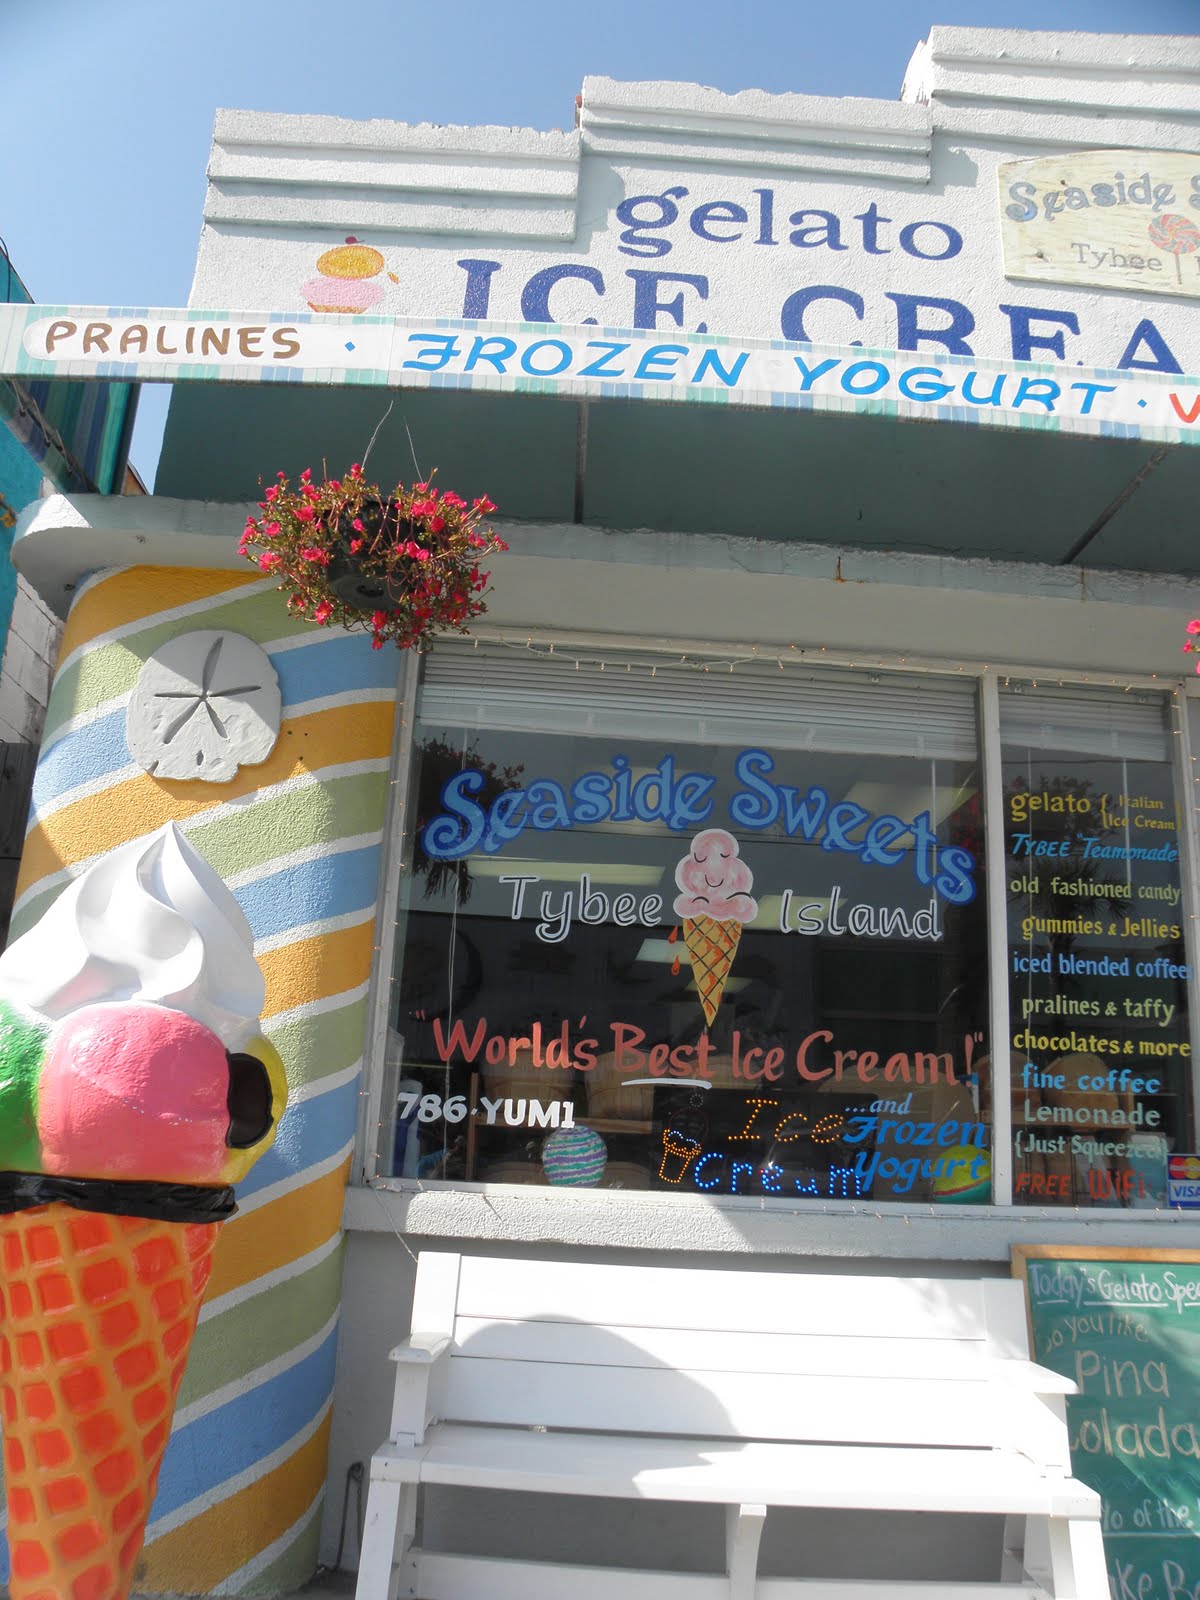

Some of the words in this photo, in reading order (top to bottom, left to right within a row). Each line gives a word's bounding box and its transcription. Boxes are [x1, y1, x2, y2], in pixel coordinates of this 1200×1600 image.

[1005, 172, 1176, 221] Seaside
[616, 186, 964, 260] gelato
[1071, 242, 1163, 272] Tybee
[457, 258, 710, 334] ICE
[45, 320, 301, 360] PRALINES
[402, 333, 751, 387] FROZEN
[793, 356, 1118, 415] YOGURT
[1010, 792, 1092, 822] gelato
[1119, 794, 1164, 810] Italian
[1134, 815, 1176, 831] Cream
[420, 752, 717, 861] Seaside
[731, 748, 977, 907] Sweets
[1010, 875, 1040, 894] old
[1050, 876, 1132, 899] fashioned
[1138, 883, 1182, 906] candy
[499, 873, 664, 943] Tybee
[779, 887, 944, 942] Island
[1021, 915, 1103, 941] gummies
[1120, 917, 1182, 939] Jellies
[1013, 951, 1052, 973] iced
[1058, 953, 1130, 977] blended
[1022, 995, 1100, 1019] pralines
[1104, 1002, 1118, 1016] &
[1123, 998, 1175, 1027] taffy
[610, 1021, 717, 1079] Best
[731, 1030, 785, 1082] Ice
[1013, 1028, 1120, 1054] chocolates
[1139, 1040, 1192, 1057] more
[1020, 1062, 1066, 1090] fine
[1077, 1069, 1162, 1094] coffee
[727, 1098, 845, 1143] Ice
[1024, 1098, 1161, 1127] Lemonade
[842, 1116, 987, 1149] Frozen
[853, 1151, 987, 1194] Yogurt
[1015, 1172, 1072, 1197] FREE
[1088, 1168, 1146, 1200] WiFi
[1028, 1263, 1096, 1309] Today's
[1098, 1269, 1162, 1302] Gelato
[1064, 1313, 1104, 1344] you
[1108, 1312, 1149, 1343] like
[1075, 1350, 1170, 1398] Pina
[1069, 1407, 1200, 1460] olada
[1133, 1498, 1154, 1528] of
[1157, 1498, 1194, 1529] the
